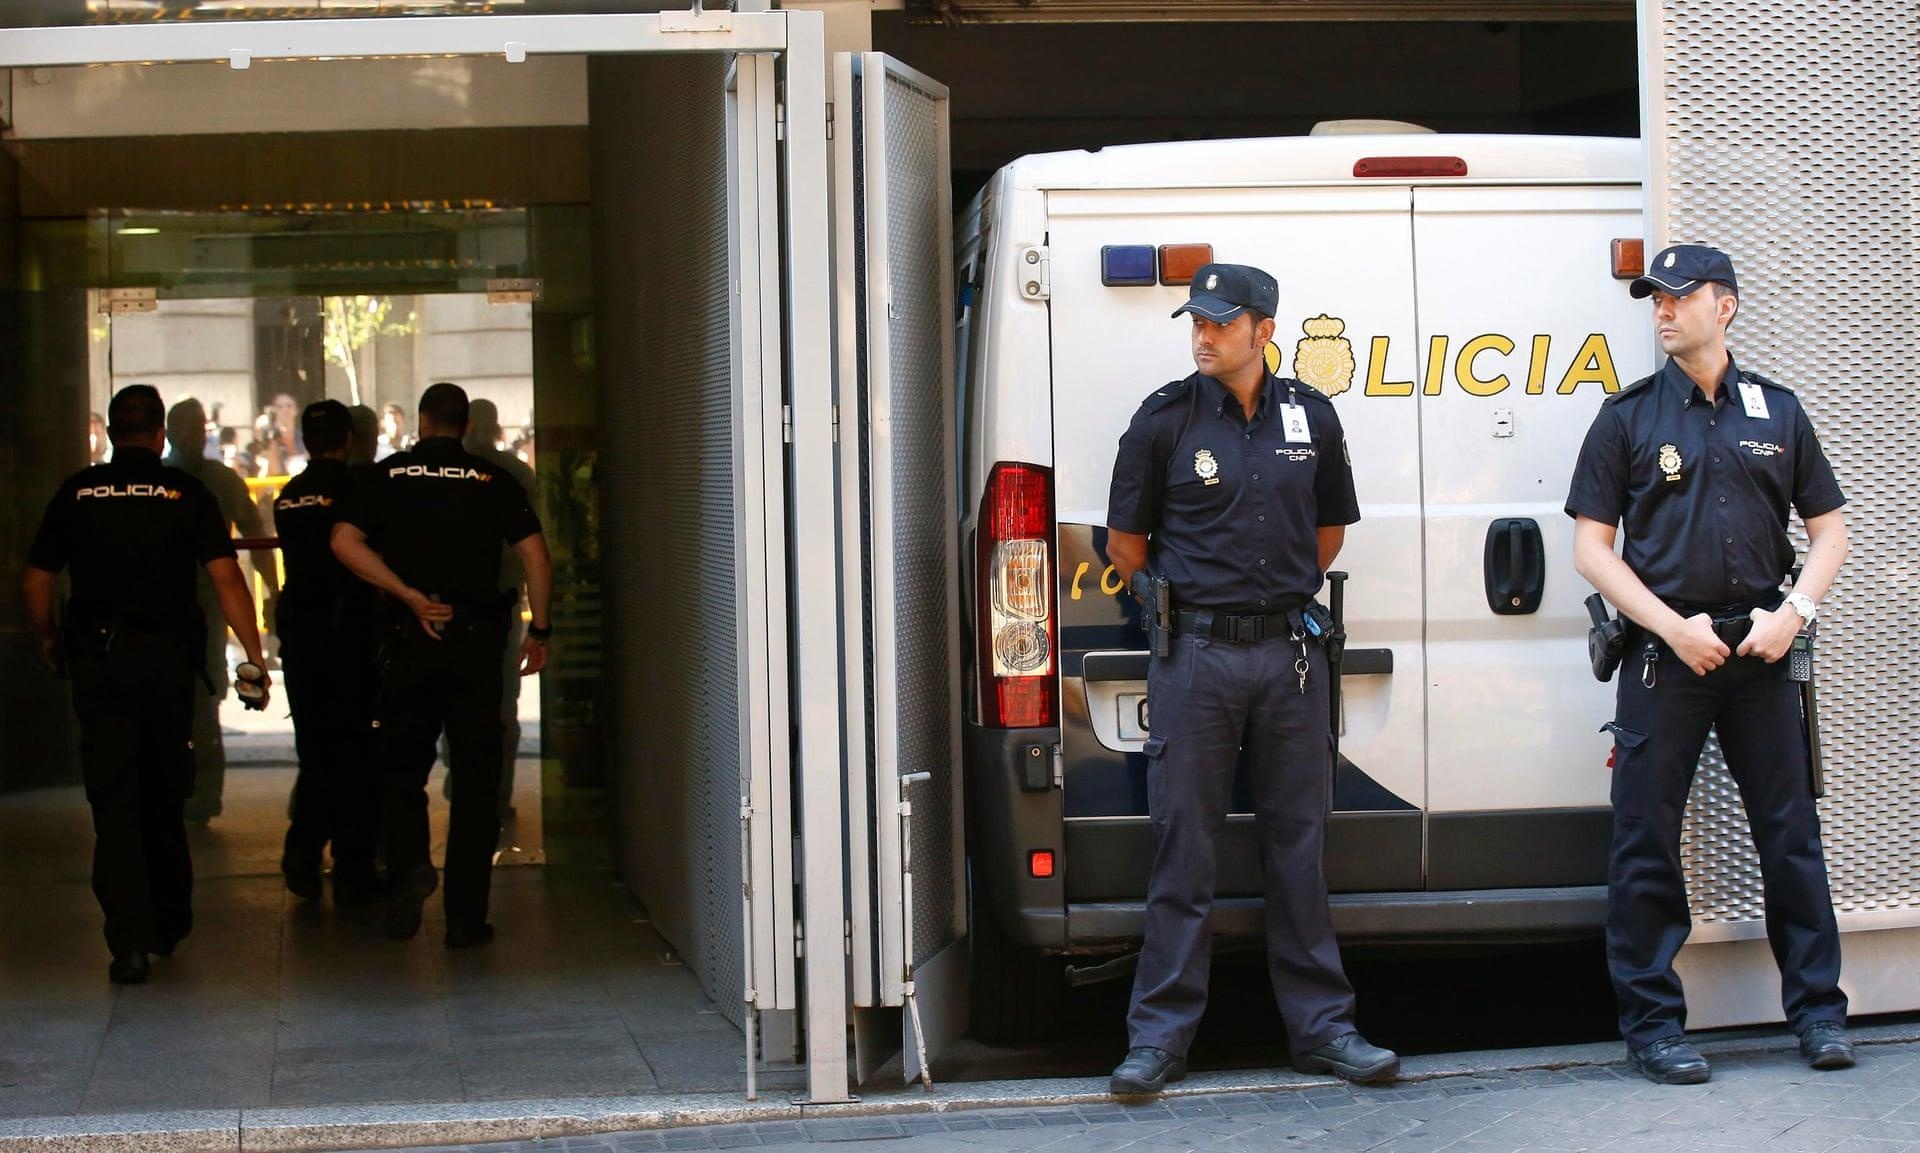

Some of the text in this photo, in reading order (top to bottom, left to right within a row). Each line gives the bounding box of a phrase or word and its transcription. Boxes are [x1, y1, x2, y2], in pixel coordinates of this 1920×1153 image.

[389, 465, 481, 480] POLICIA
[76, 484, 169, 501] POLICIA
[279, 494, 324, 510] OLICIA
